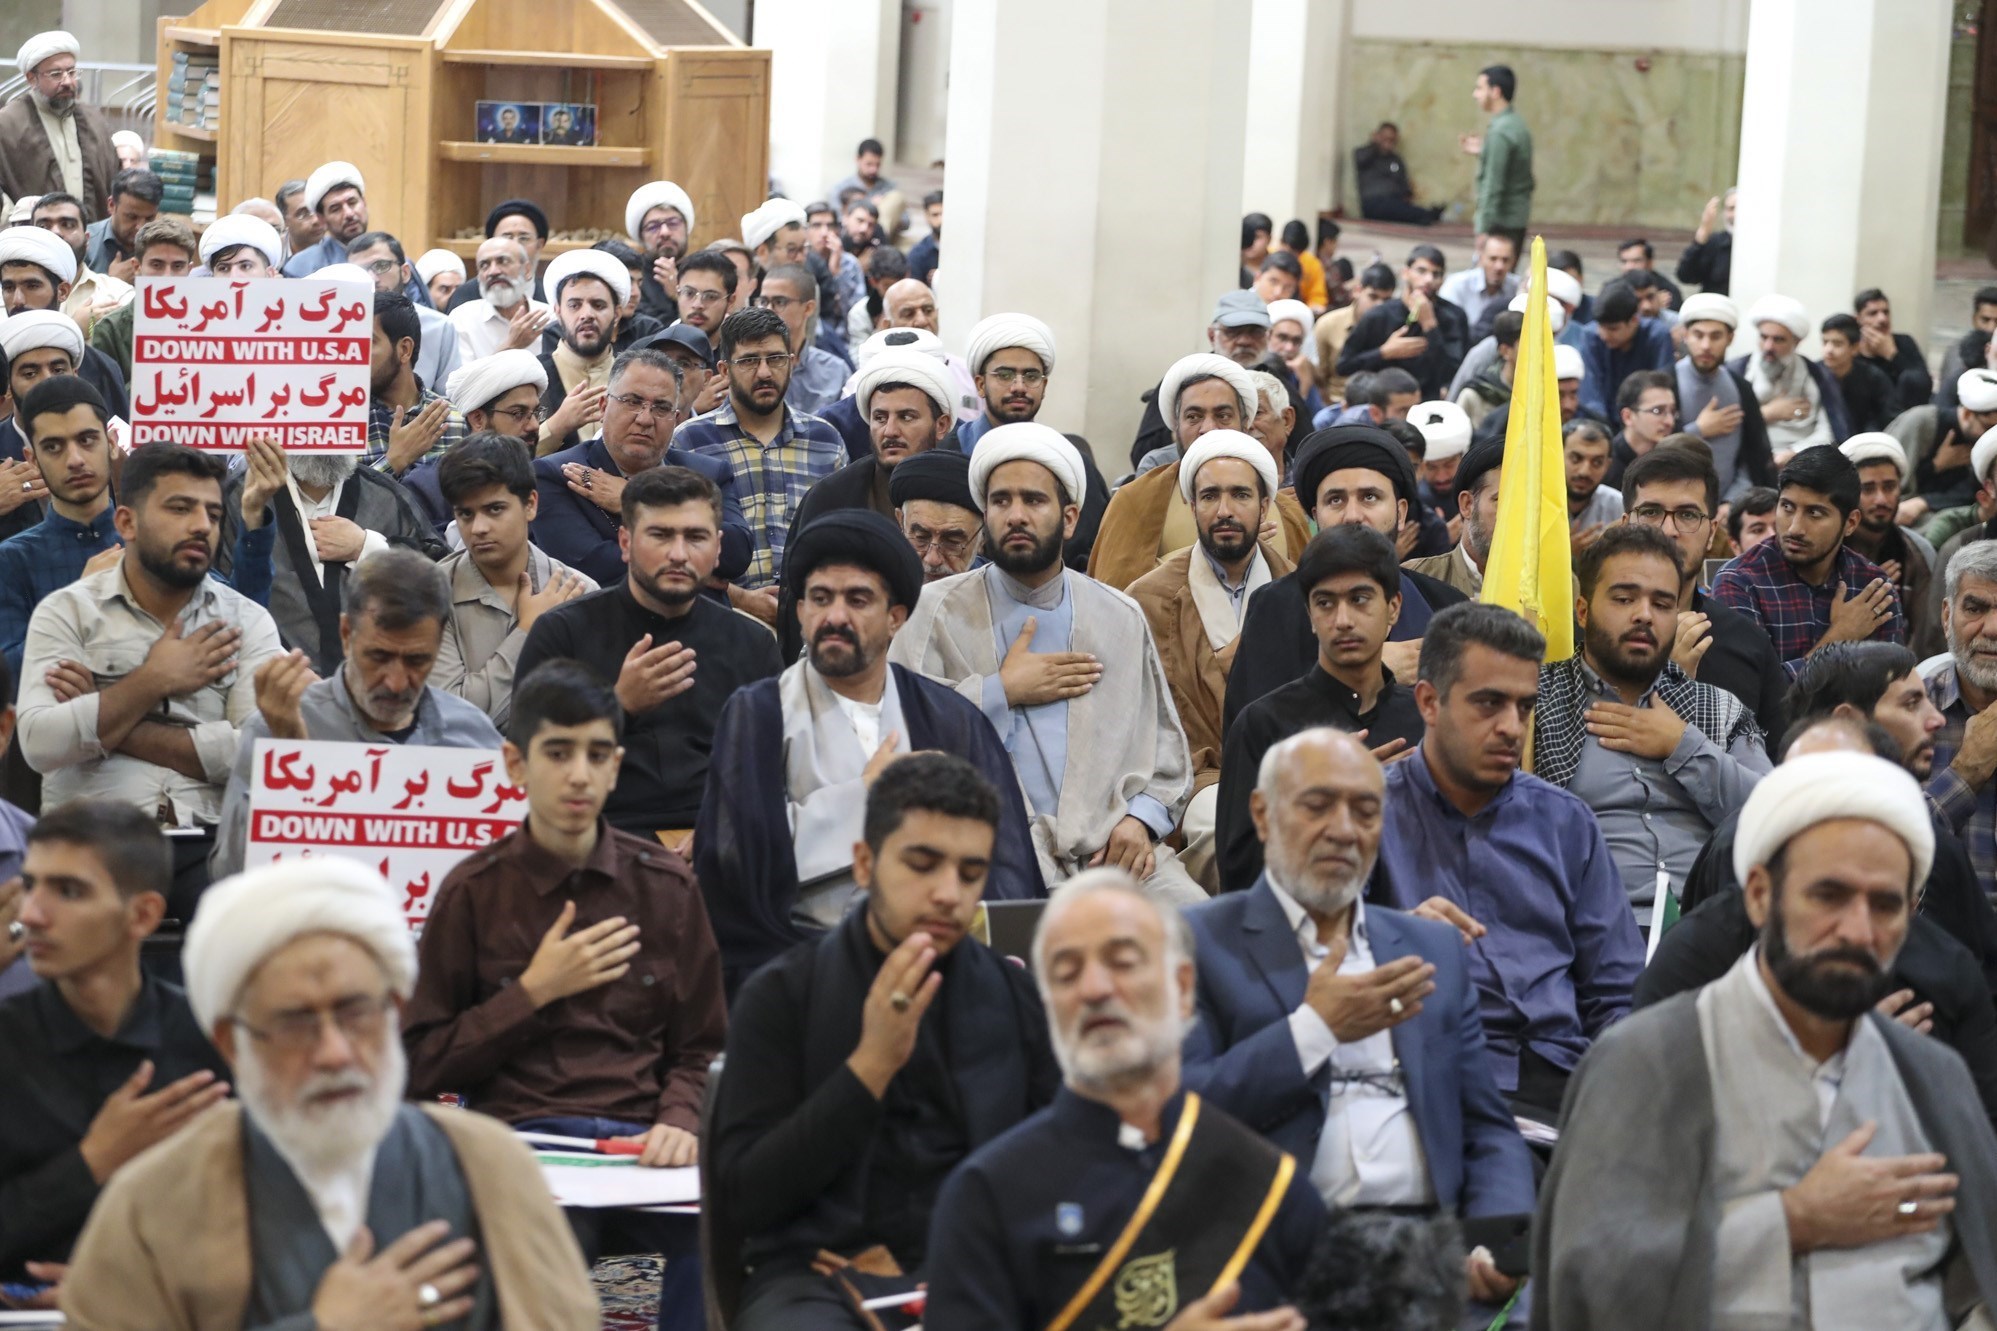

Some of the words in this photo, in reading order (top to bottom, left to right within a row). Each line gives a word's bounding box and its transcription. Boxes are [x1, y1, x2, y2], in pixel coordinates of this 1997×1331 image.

[143, 281, 250, 332] آمریکا
[255, 297, 285, 333] بر
[299, 288, 366, 333] مرگ
[143, 340, 224, 360] DOWN
[232, 341, 294, 360] WITH
[301, 342, 363, 361] U.S.A
[135, 367, 255, 418] اسرائیل
[261, 383, 291, 418] بر
[300, 373, 366, 418] مرگ
[134, 425, 217, 445] DOWN
[287, 426, 364, 445] ISRAEL
[264, 748, 390, 807] آمریکا
[391, 769, 429, 810] بر
[260, 815, 355, 839] DOWN
[364, 819, 438, 843] WITH
